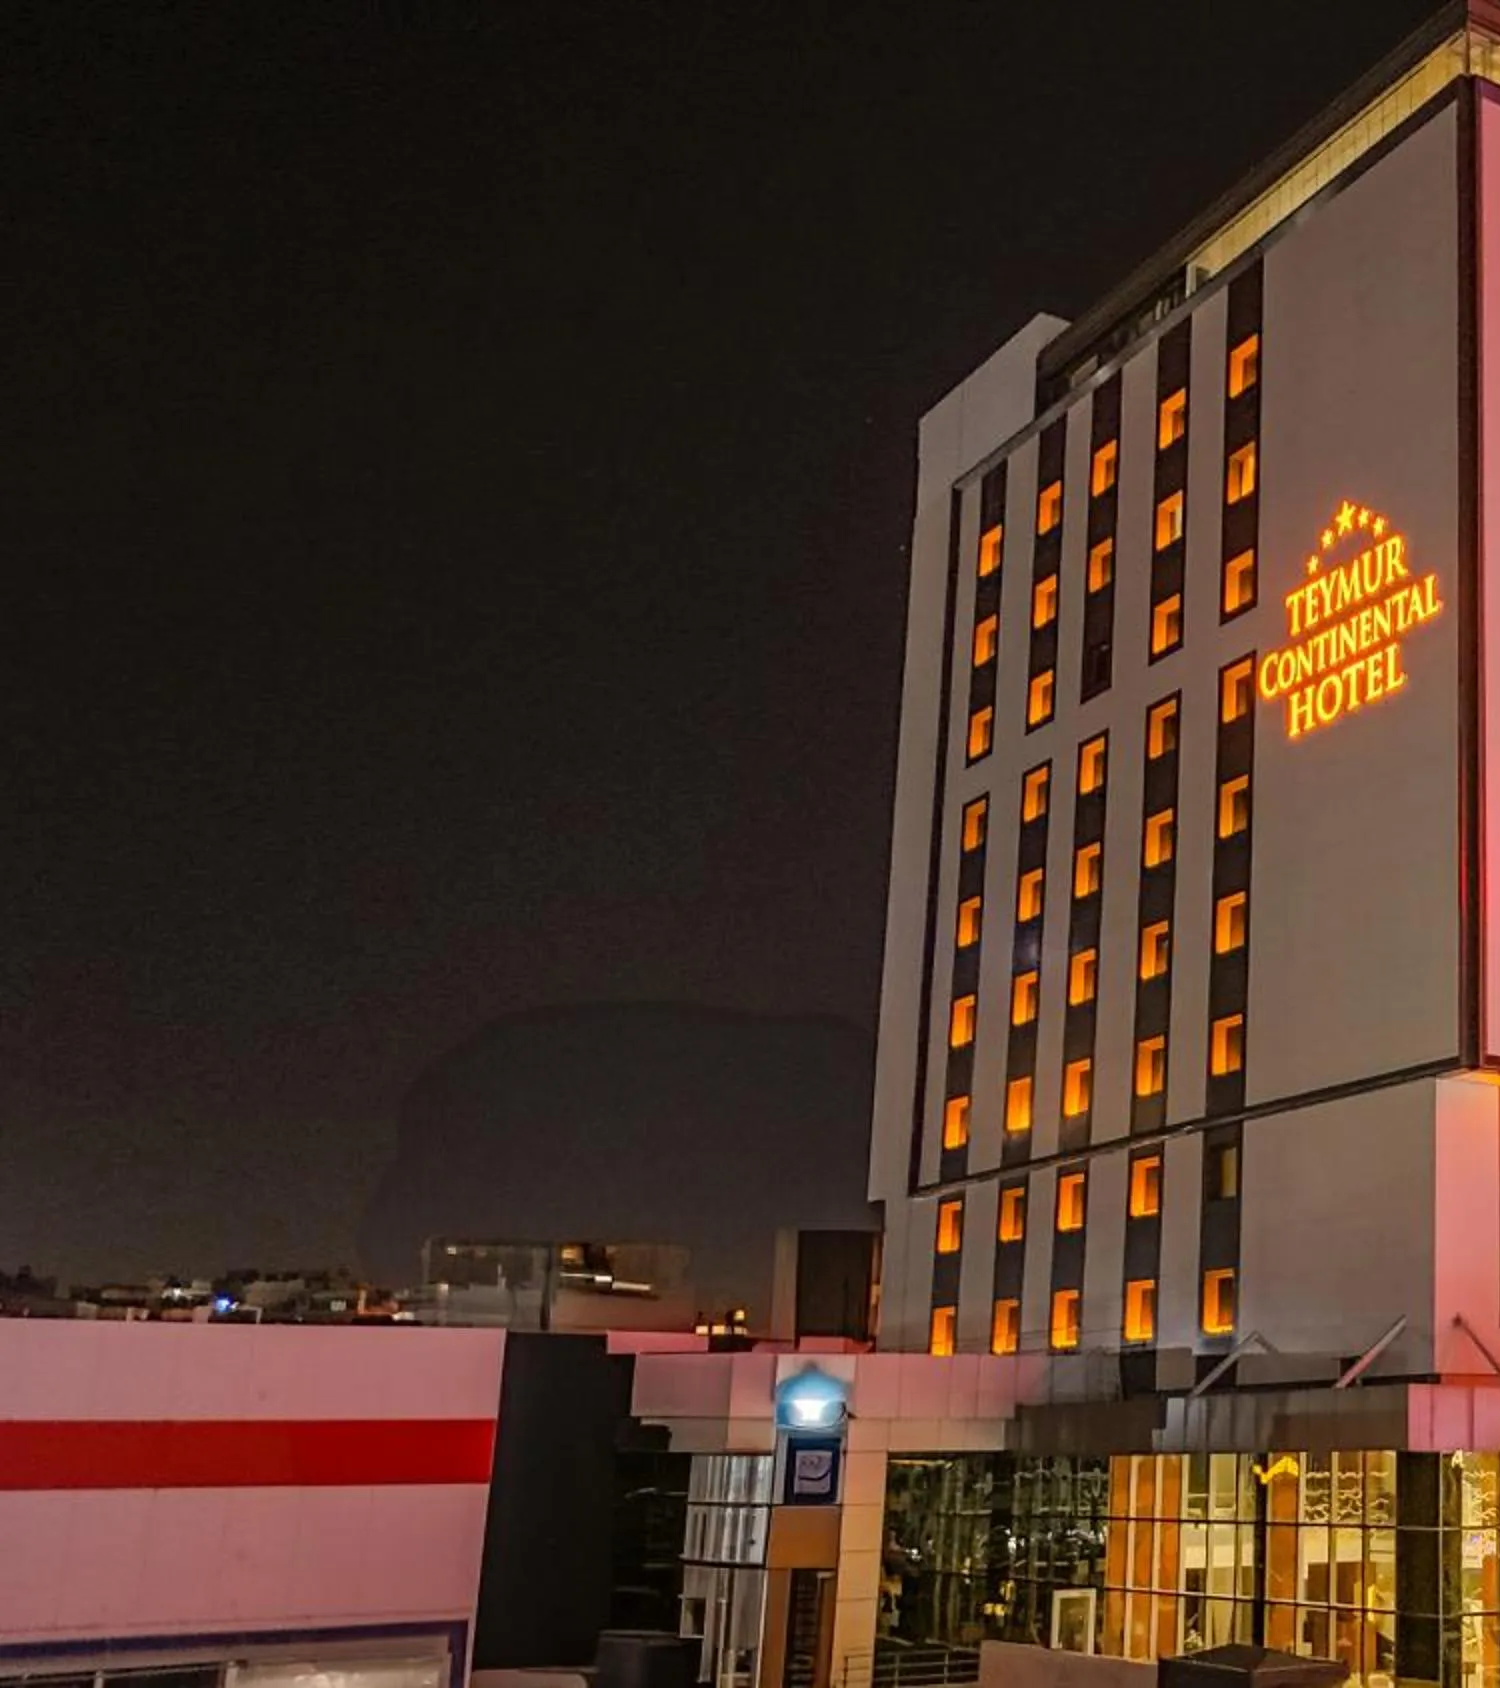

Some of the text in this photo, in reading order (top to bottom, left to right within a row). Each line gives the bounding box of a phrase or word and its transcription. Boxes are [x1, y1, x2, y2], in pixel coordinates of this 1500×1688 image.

[1259, 574, 1444, 698] CONTINENTAL
[1285, 536, 1408, 637] TEYMUR
[1288, 644, 1407, 738] HOTEL
